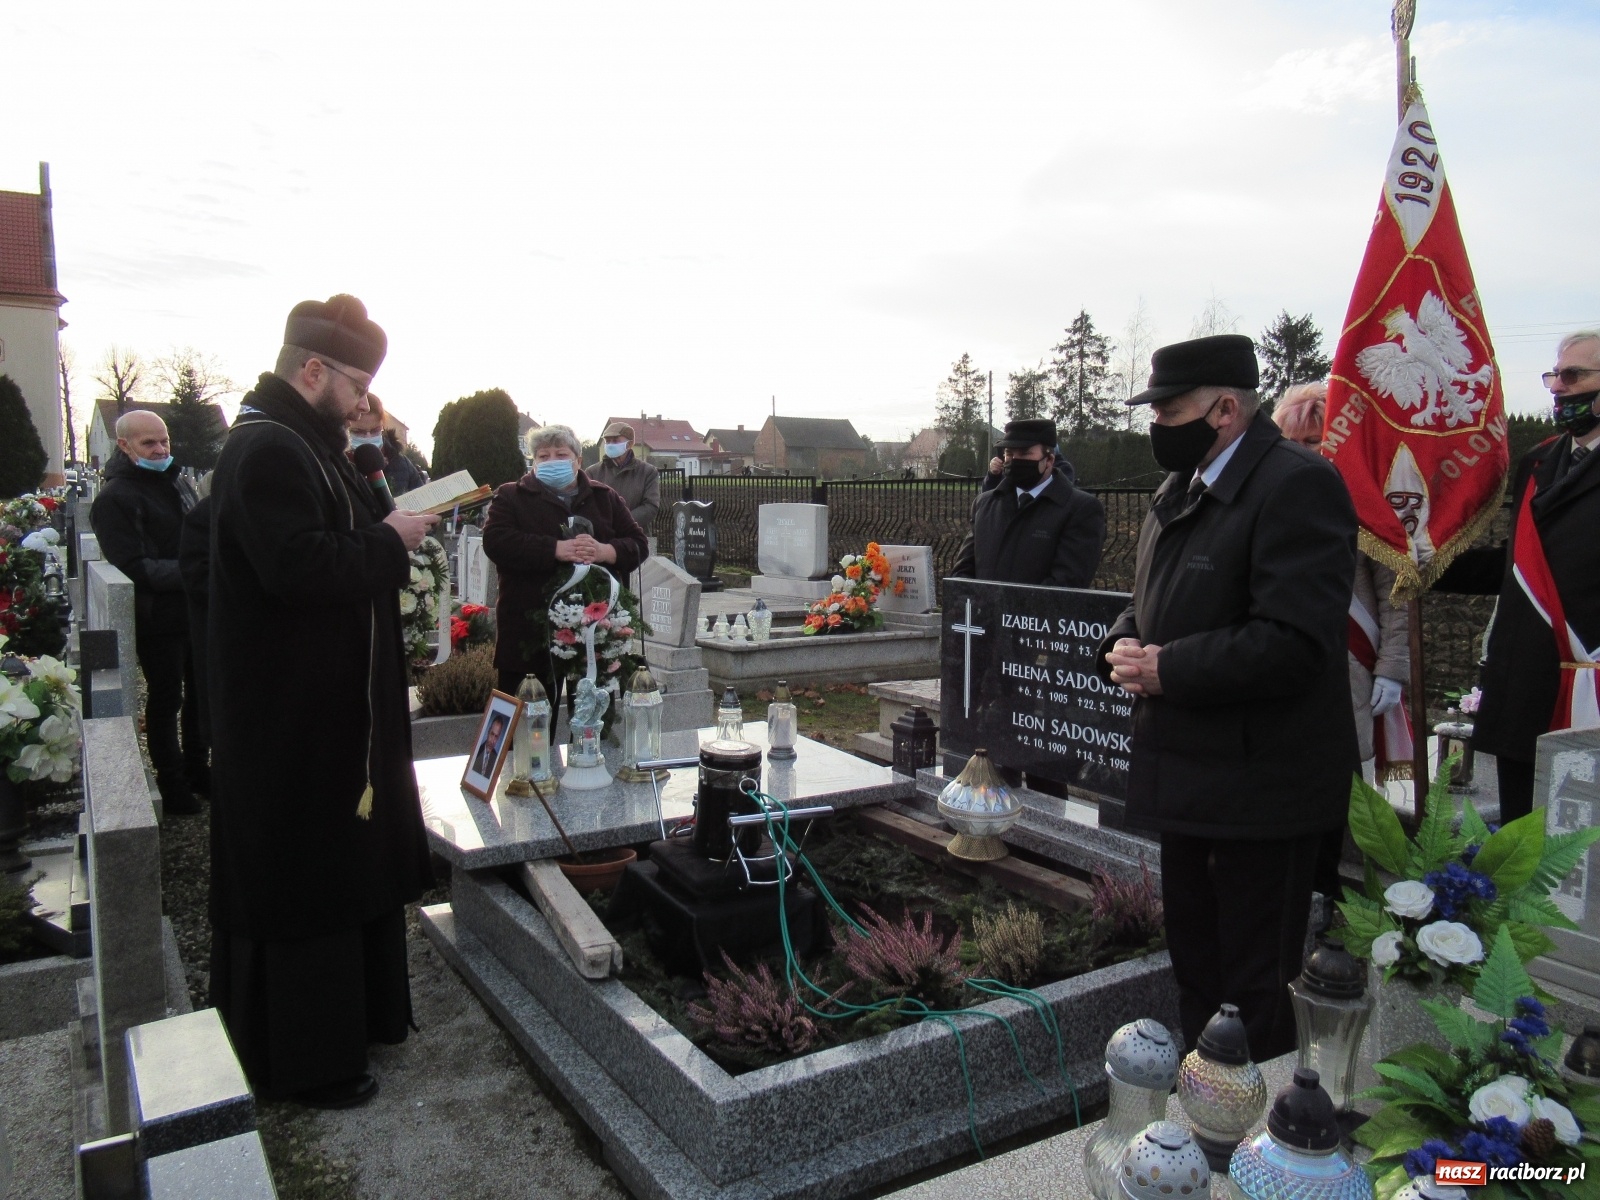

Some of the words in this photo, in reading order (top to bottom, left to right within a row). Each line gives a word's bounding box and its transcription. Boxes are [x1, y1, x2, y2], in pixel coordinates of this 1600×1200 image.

[1395, 120, 1438, 208] 1920
[1321, 393, 1368, 463] MPER
[897, 565, 915, 573] JERZY
[1002, 614, 1051, 633] IZABELA
[1035, 639, 1047, 650] 11.
[1050, 641, 1070, 654] 1942
[1002, 661, 1051, 684] HELENA
[1036, 689, 1044, 699] 2.
[1049, 691, 1068, 704] 1905
[1099, 702, 1108, 713] 5.
[1111, 704, 1132, 717] 1984
[1012, 711, 1045, 732] LEON
[1051, 718, 1132, 753] SADOWSK
[1033, 738, 1045, 750] 10.
[1048, 741, 1067, 755] 1909
[1098, 754, 1107, 765] 3.
